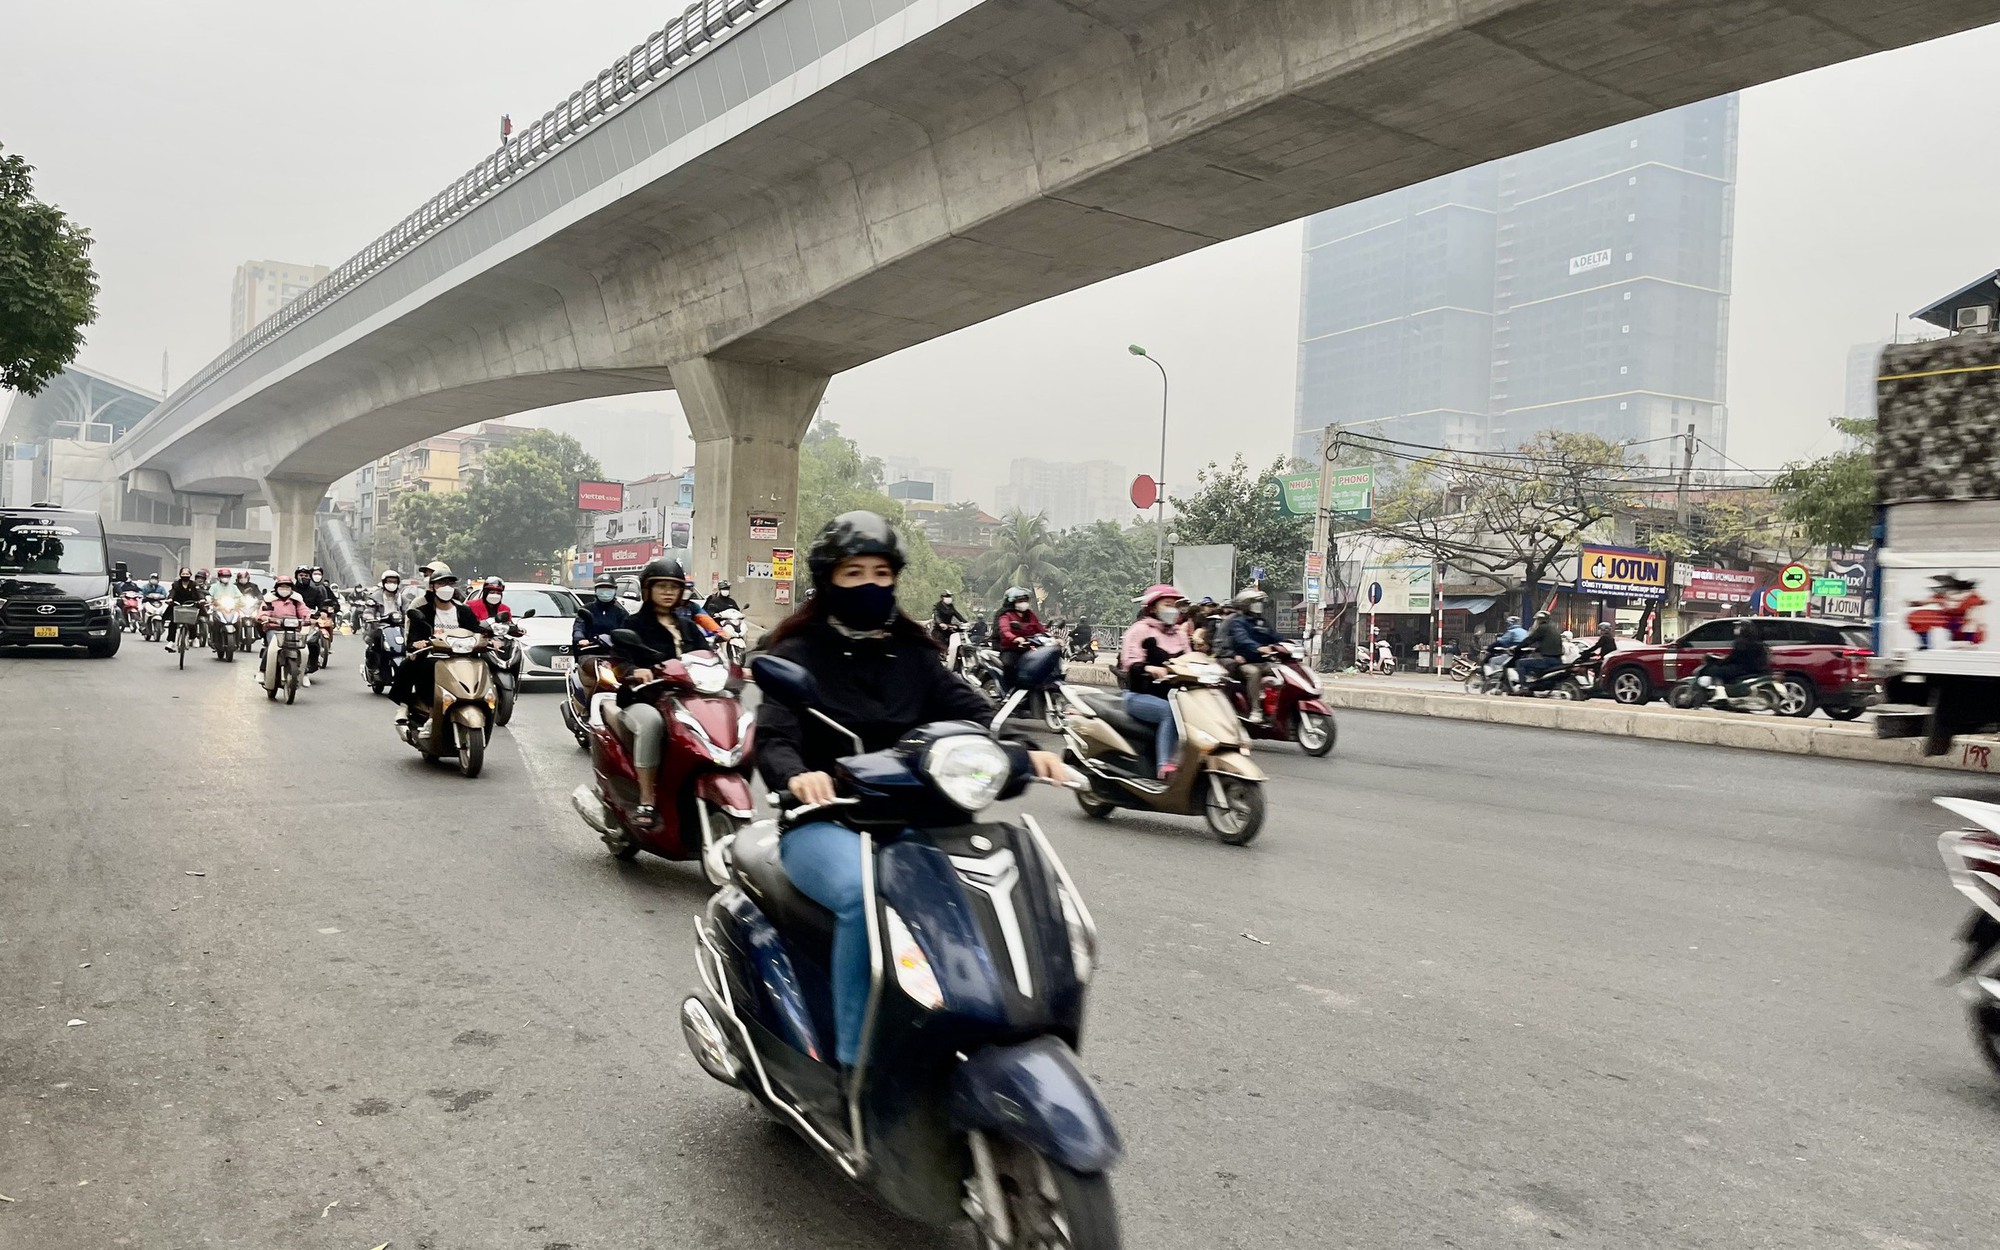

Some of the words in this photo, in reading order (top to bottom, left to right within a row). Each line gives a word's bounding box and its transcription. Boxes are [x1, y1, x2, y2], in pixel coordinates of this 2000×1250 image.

[1580, 251, 1608, 267] DELTA
[1339, 473, 1369, 486] PHONG
[1608, 558, 1659, 581] JOTUN
[1828, 571, 1860, 586] Dlux
[1835, 600, 1860, 614] JOTUN
